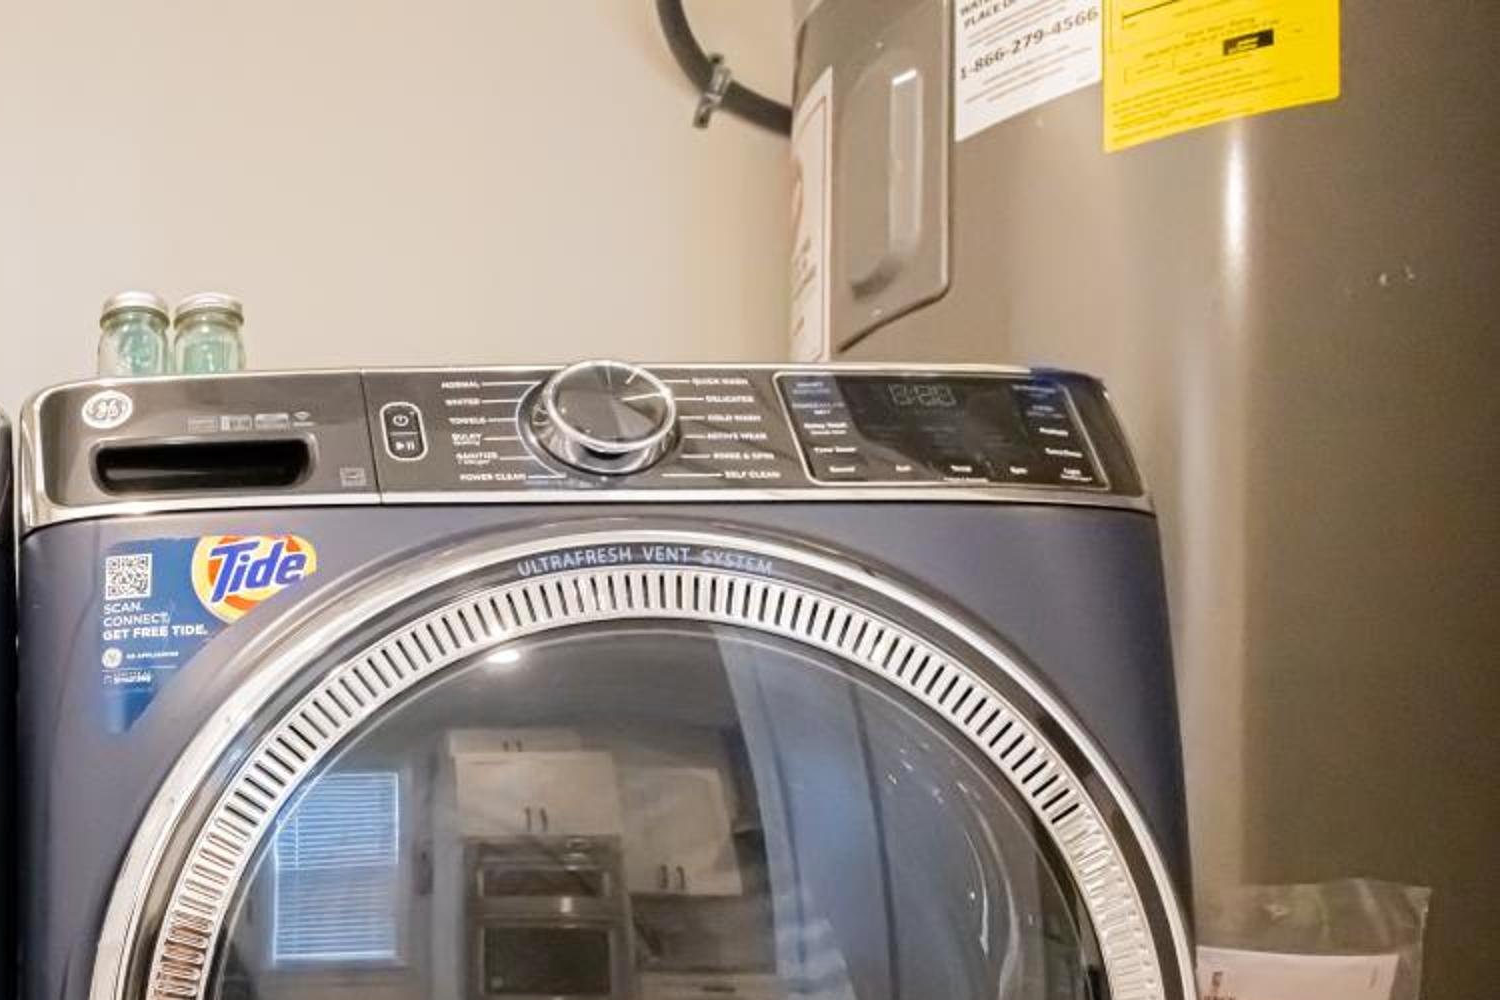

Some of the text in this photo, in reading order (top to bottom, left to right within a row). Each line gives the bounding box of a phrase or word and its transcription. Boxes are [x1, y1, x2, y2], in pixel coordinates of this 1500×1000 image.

[959, 7, 1098, 80] 1-866-279-4566
[209, 541, 308, 604] Tide
[517, 546, 774, 577] ULTRAFRESH VENT SYSTEM
[103, 601, 143, 615] SCAN.
[103, 624, 208, 640] GET FREE TIDE.
